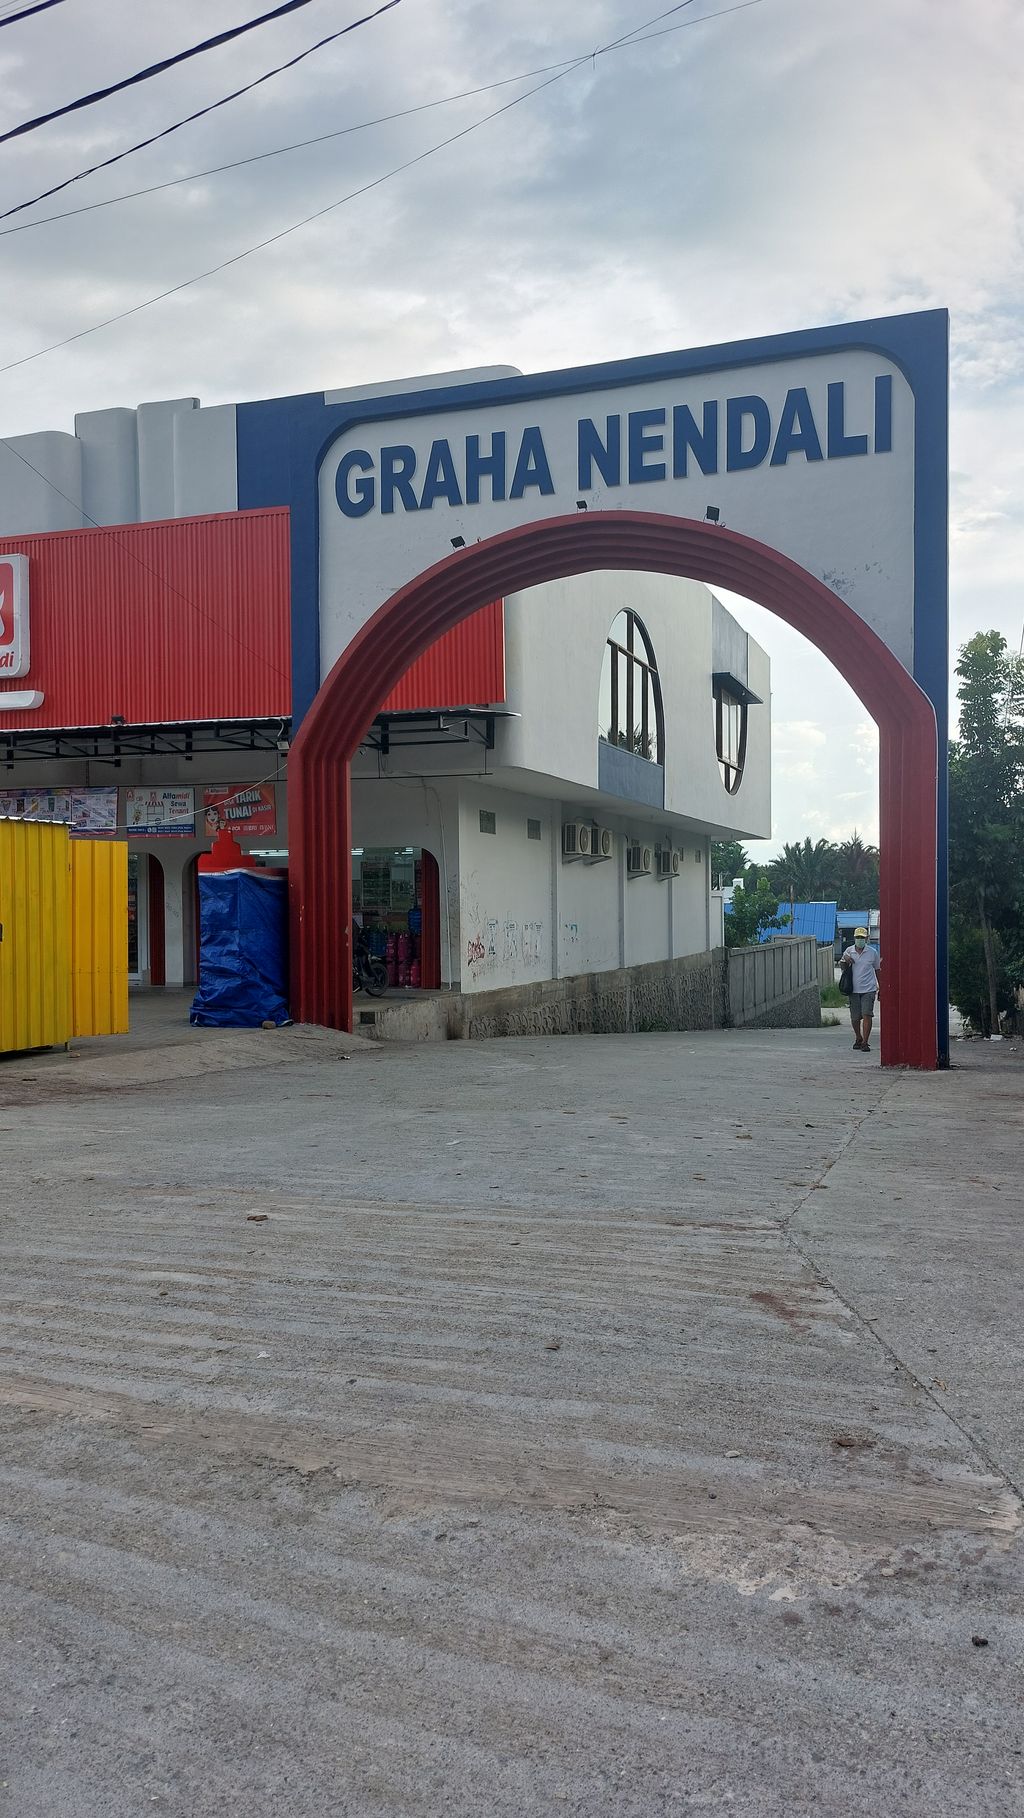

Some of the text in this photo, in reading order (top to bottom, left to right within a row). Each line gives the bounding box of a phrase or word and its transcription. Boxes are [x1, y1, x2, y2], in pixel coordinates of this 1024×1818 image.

[335, 375, 893, 518] GRAHA NENDALI
[235, 790, 262, 804] TARIK
[224, 805, 253, 819] TUNAI
